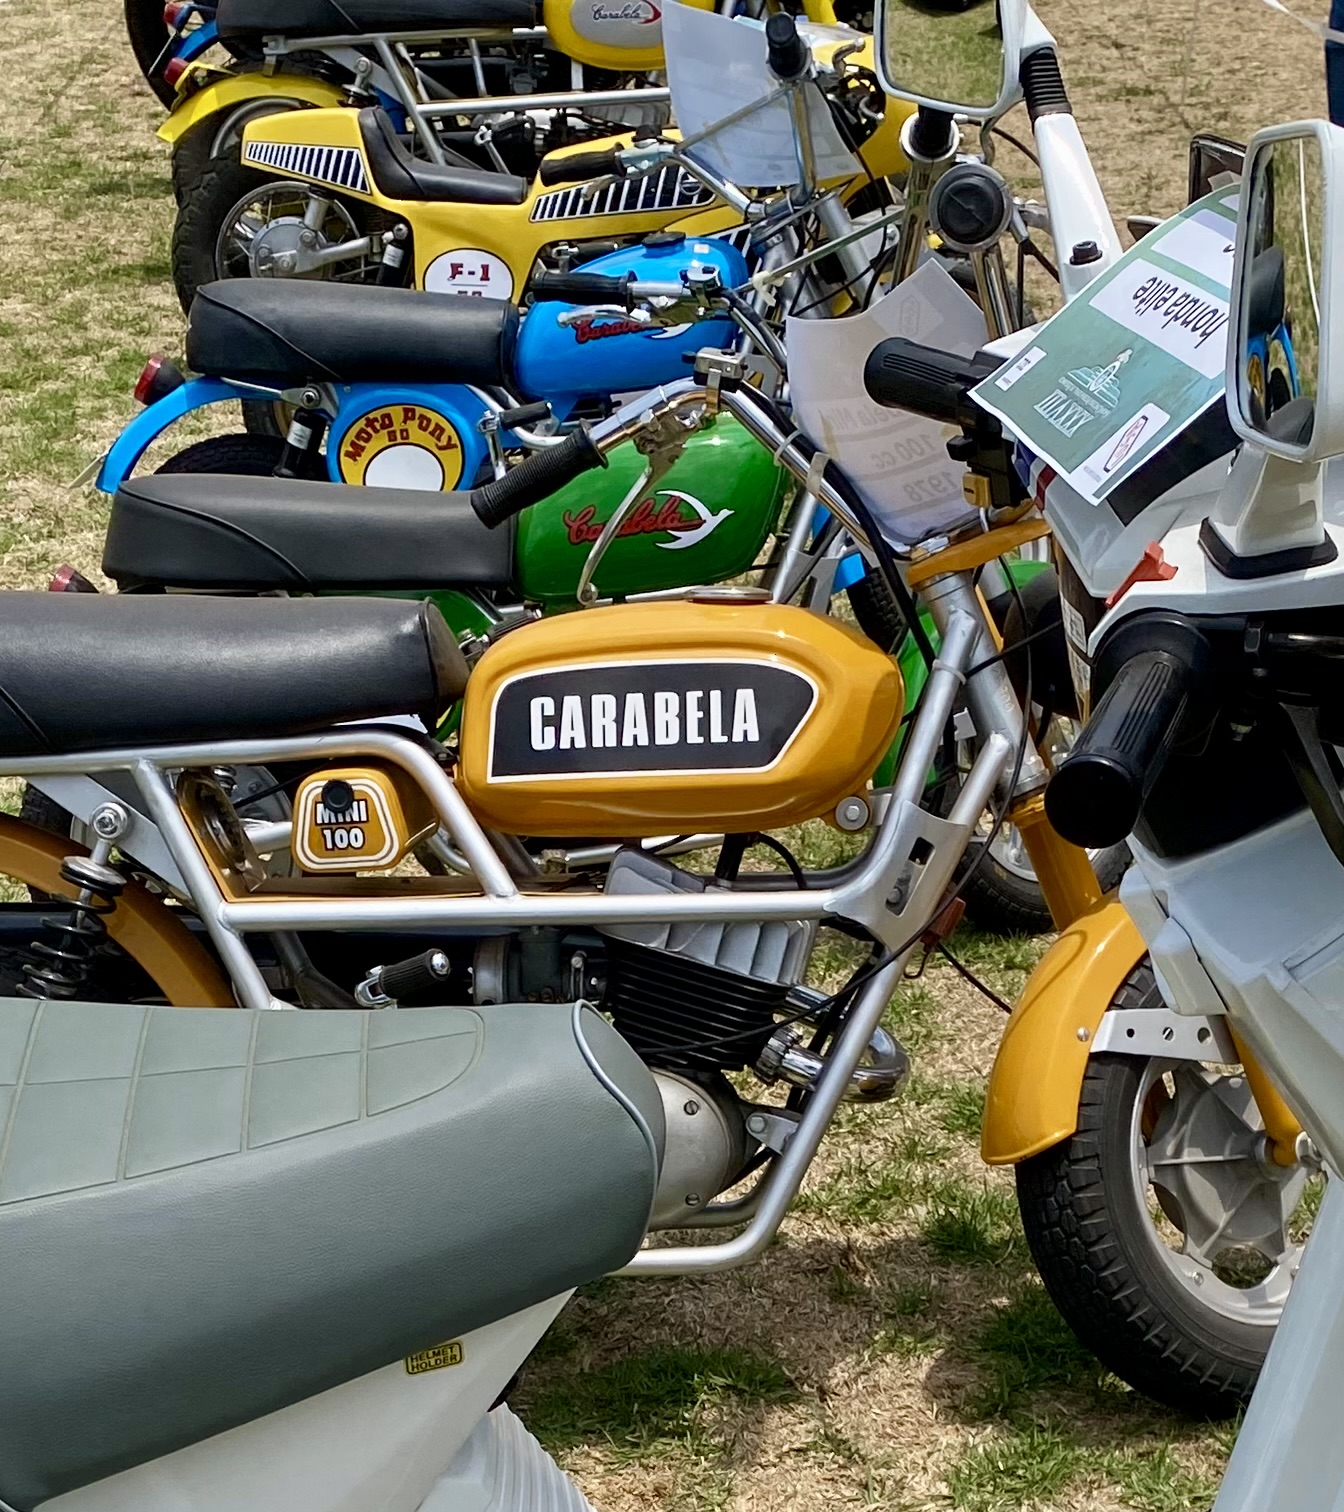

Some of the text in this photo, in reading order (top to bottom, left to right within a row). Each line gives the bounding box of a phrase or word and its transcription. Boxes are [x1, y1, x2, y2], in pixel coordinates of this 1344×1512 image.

[1133, 276, 1229, 349] honda elite
[344, 407, 458, 462] Moto Pony
[530, 688, 760, 751] CARABELA
[323, 827, 364, 850] 100
[410, 1345, 455, 1363] HELMET
[411, 1353, 459, 1372] HOLDER
